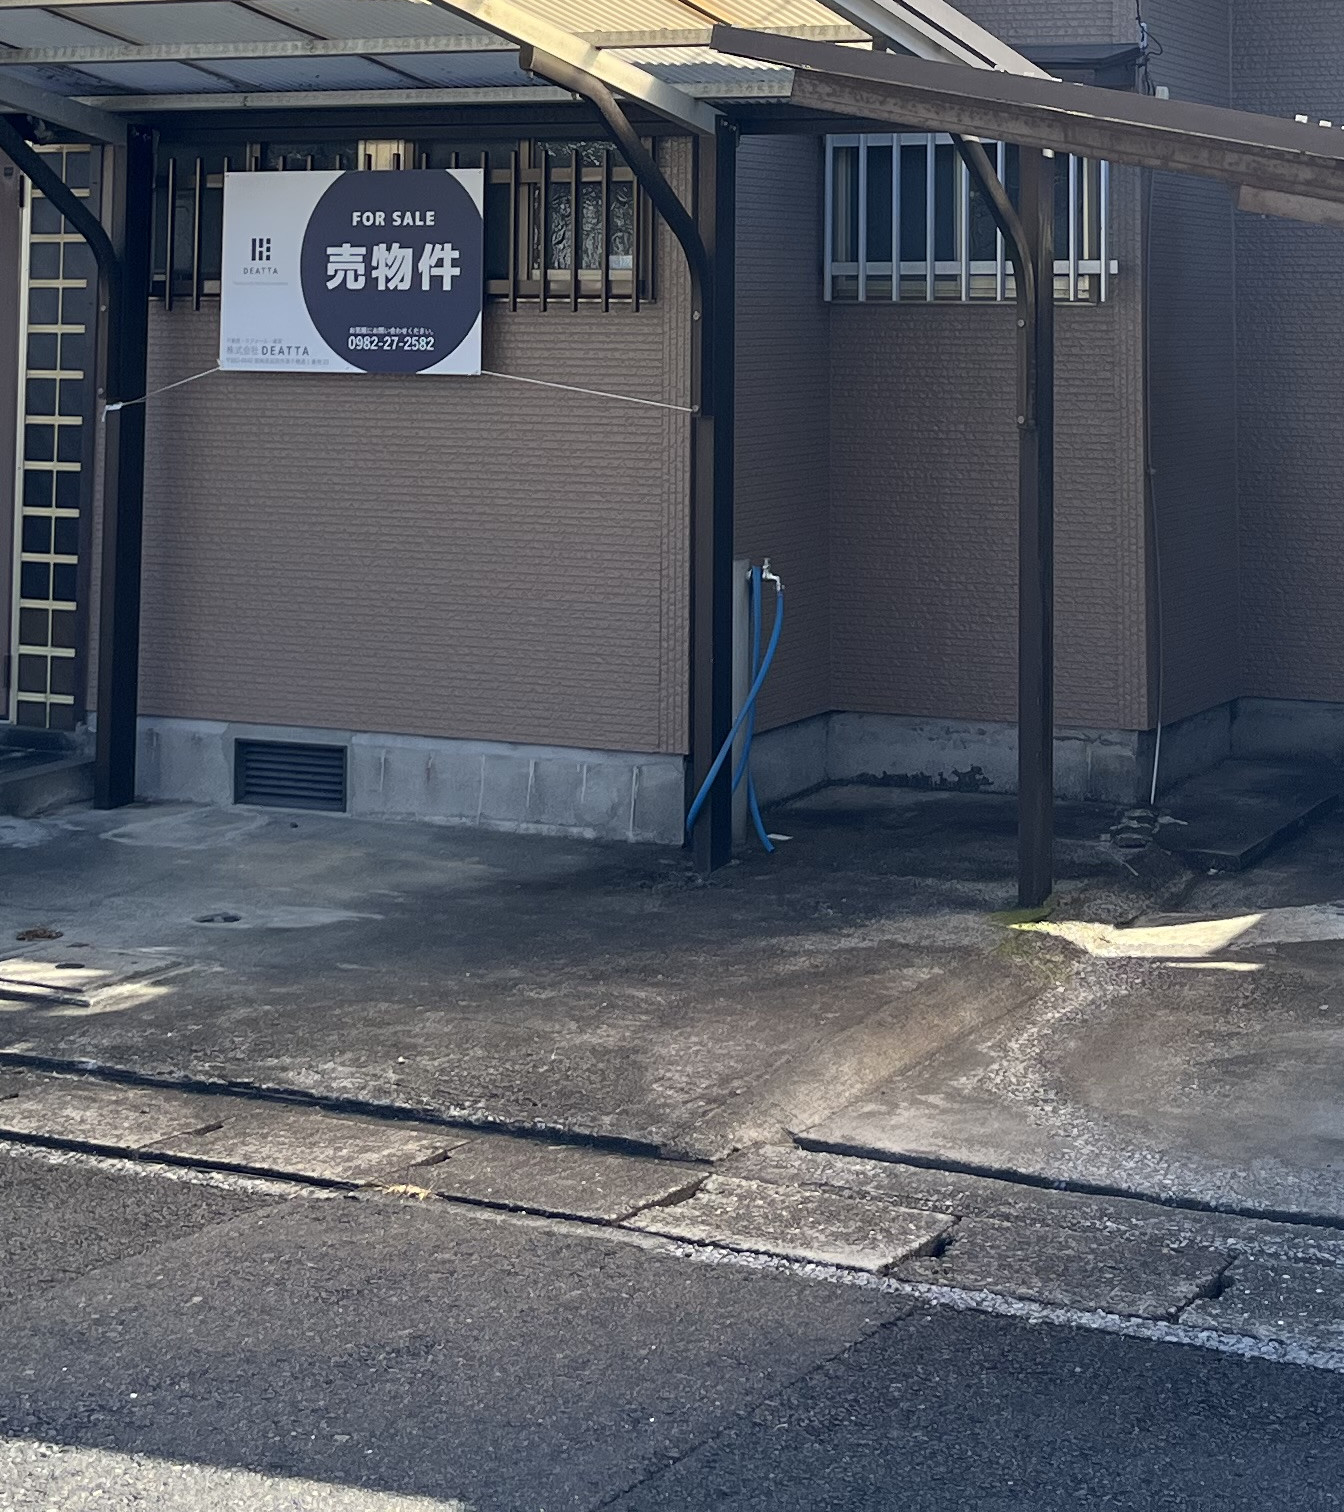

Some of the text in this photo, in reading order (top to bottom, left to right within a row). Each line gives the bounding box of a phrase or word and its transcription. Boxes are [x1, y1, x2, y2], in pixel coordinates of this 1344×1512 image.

[352, 211, 435, 226] FOR SALE
[243, 267, 278, 275] DEATTA
[326, 243, 461, 291] 売物件
[348, 336, 435, 350] 0982-27-2582
[261, 346, 310, 356] DEATTA
